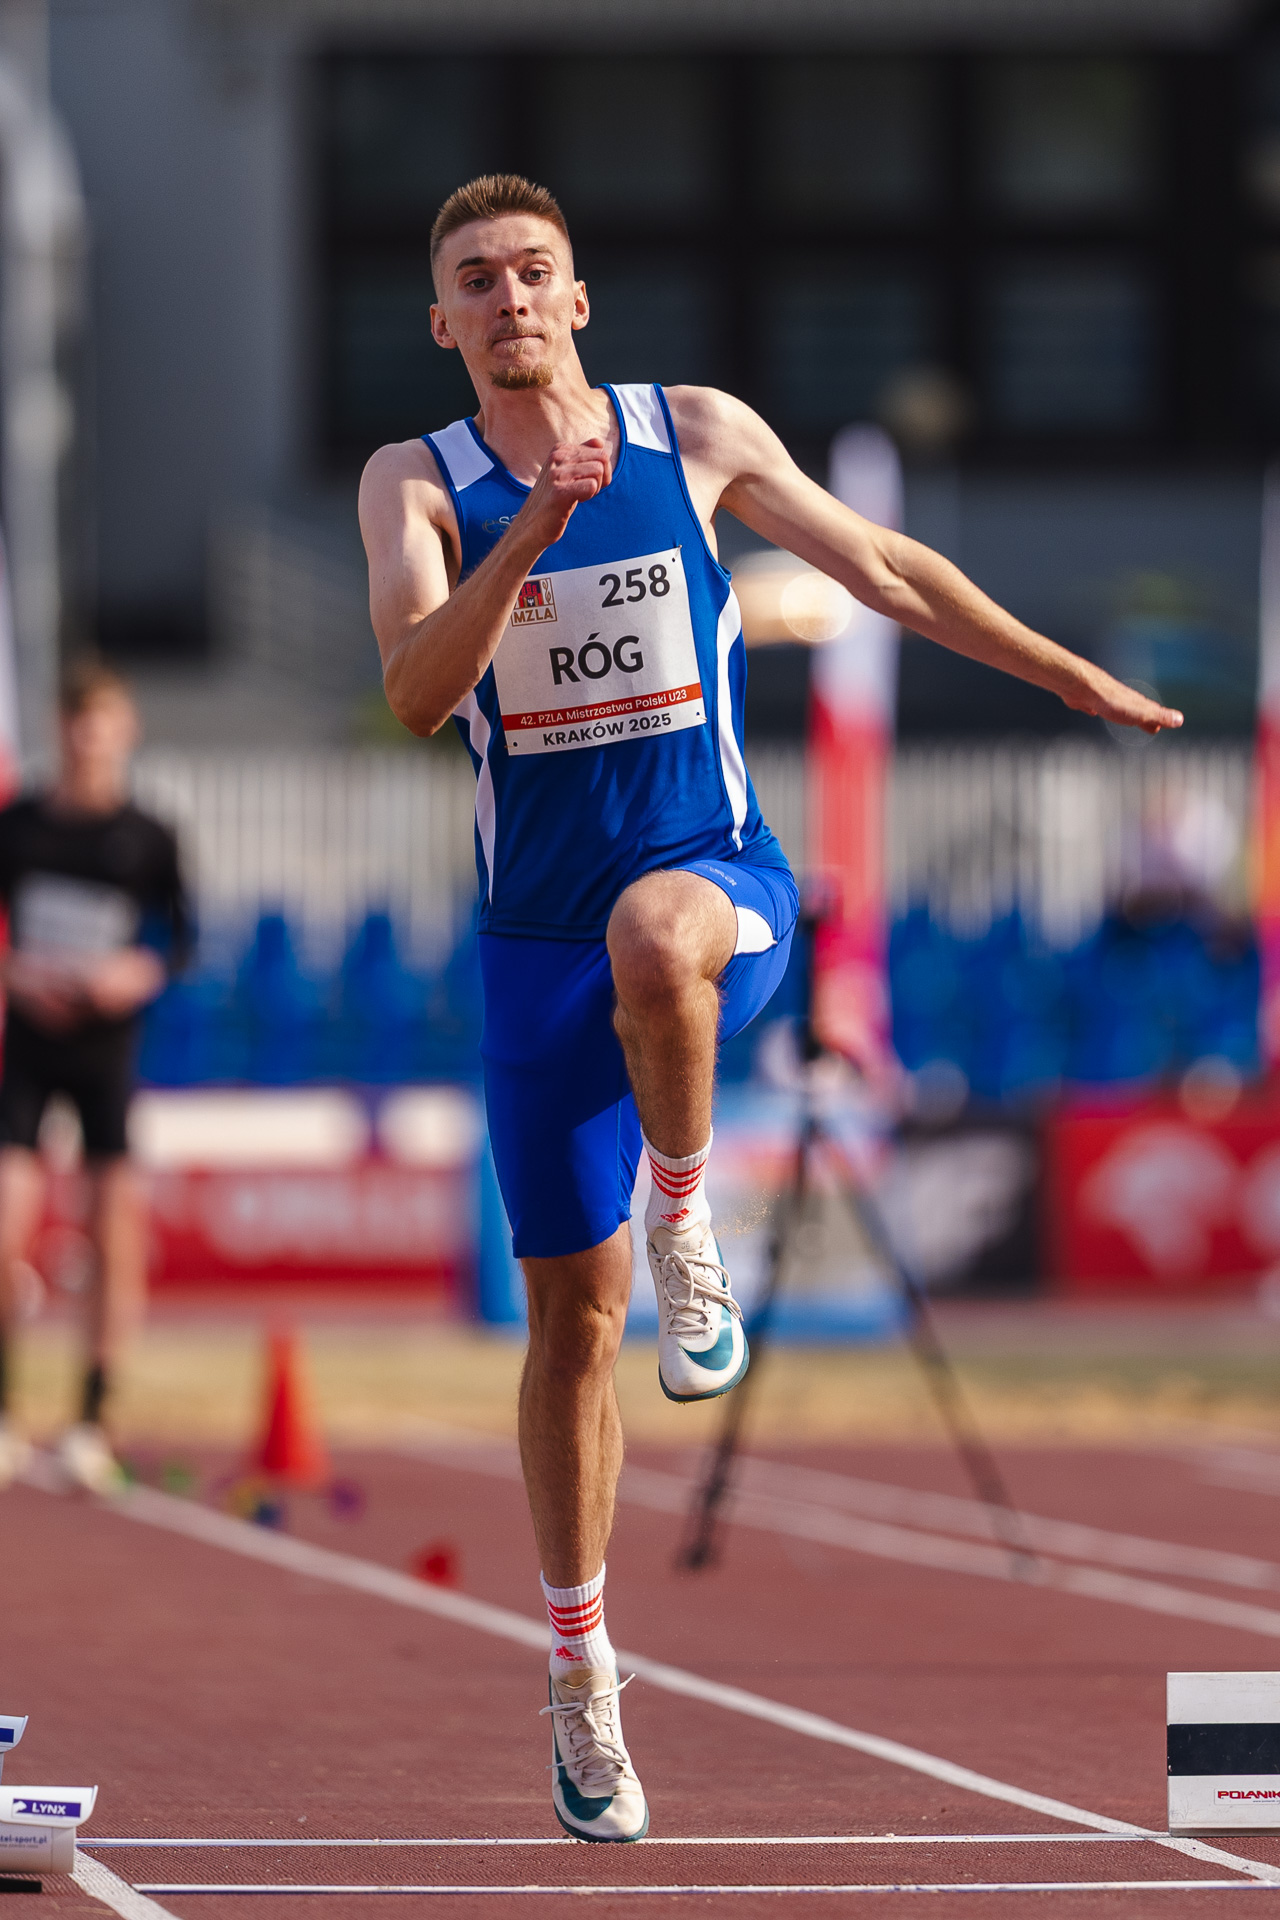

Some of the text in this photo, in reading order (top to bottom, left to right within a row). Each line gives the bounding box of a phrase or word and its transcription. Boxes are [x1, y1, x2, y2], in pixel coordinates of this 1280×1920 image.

[599, 564, 671, 608] 258
[513, 607, 554, 624] MZLA
[549, 632, 644, 685] RÓG
[520, 689, 687, 726] 42. PZLA Mistrzostwa Polski U23
[543, 712, 672, 746] KRAKÓW 2025
[32, 1802, 66, 1815] LYNX
[1217, 1790, 1280, 1799] POLANIK
